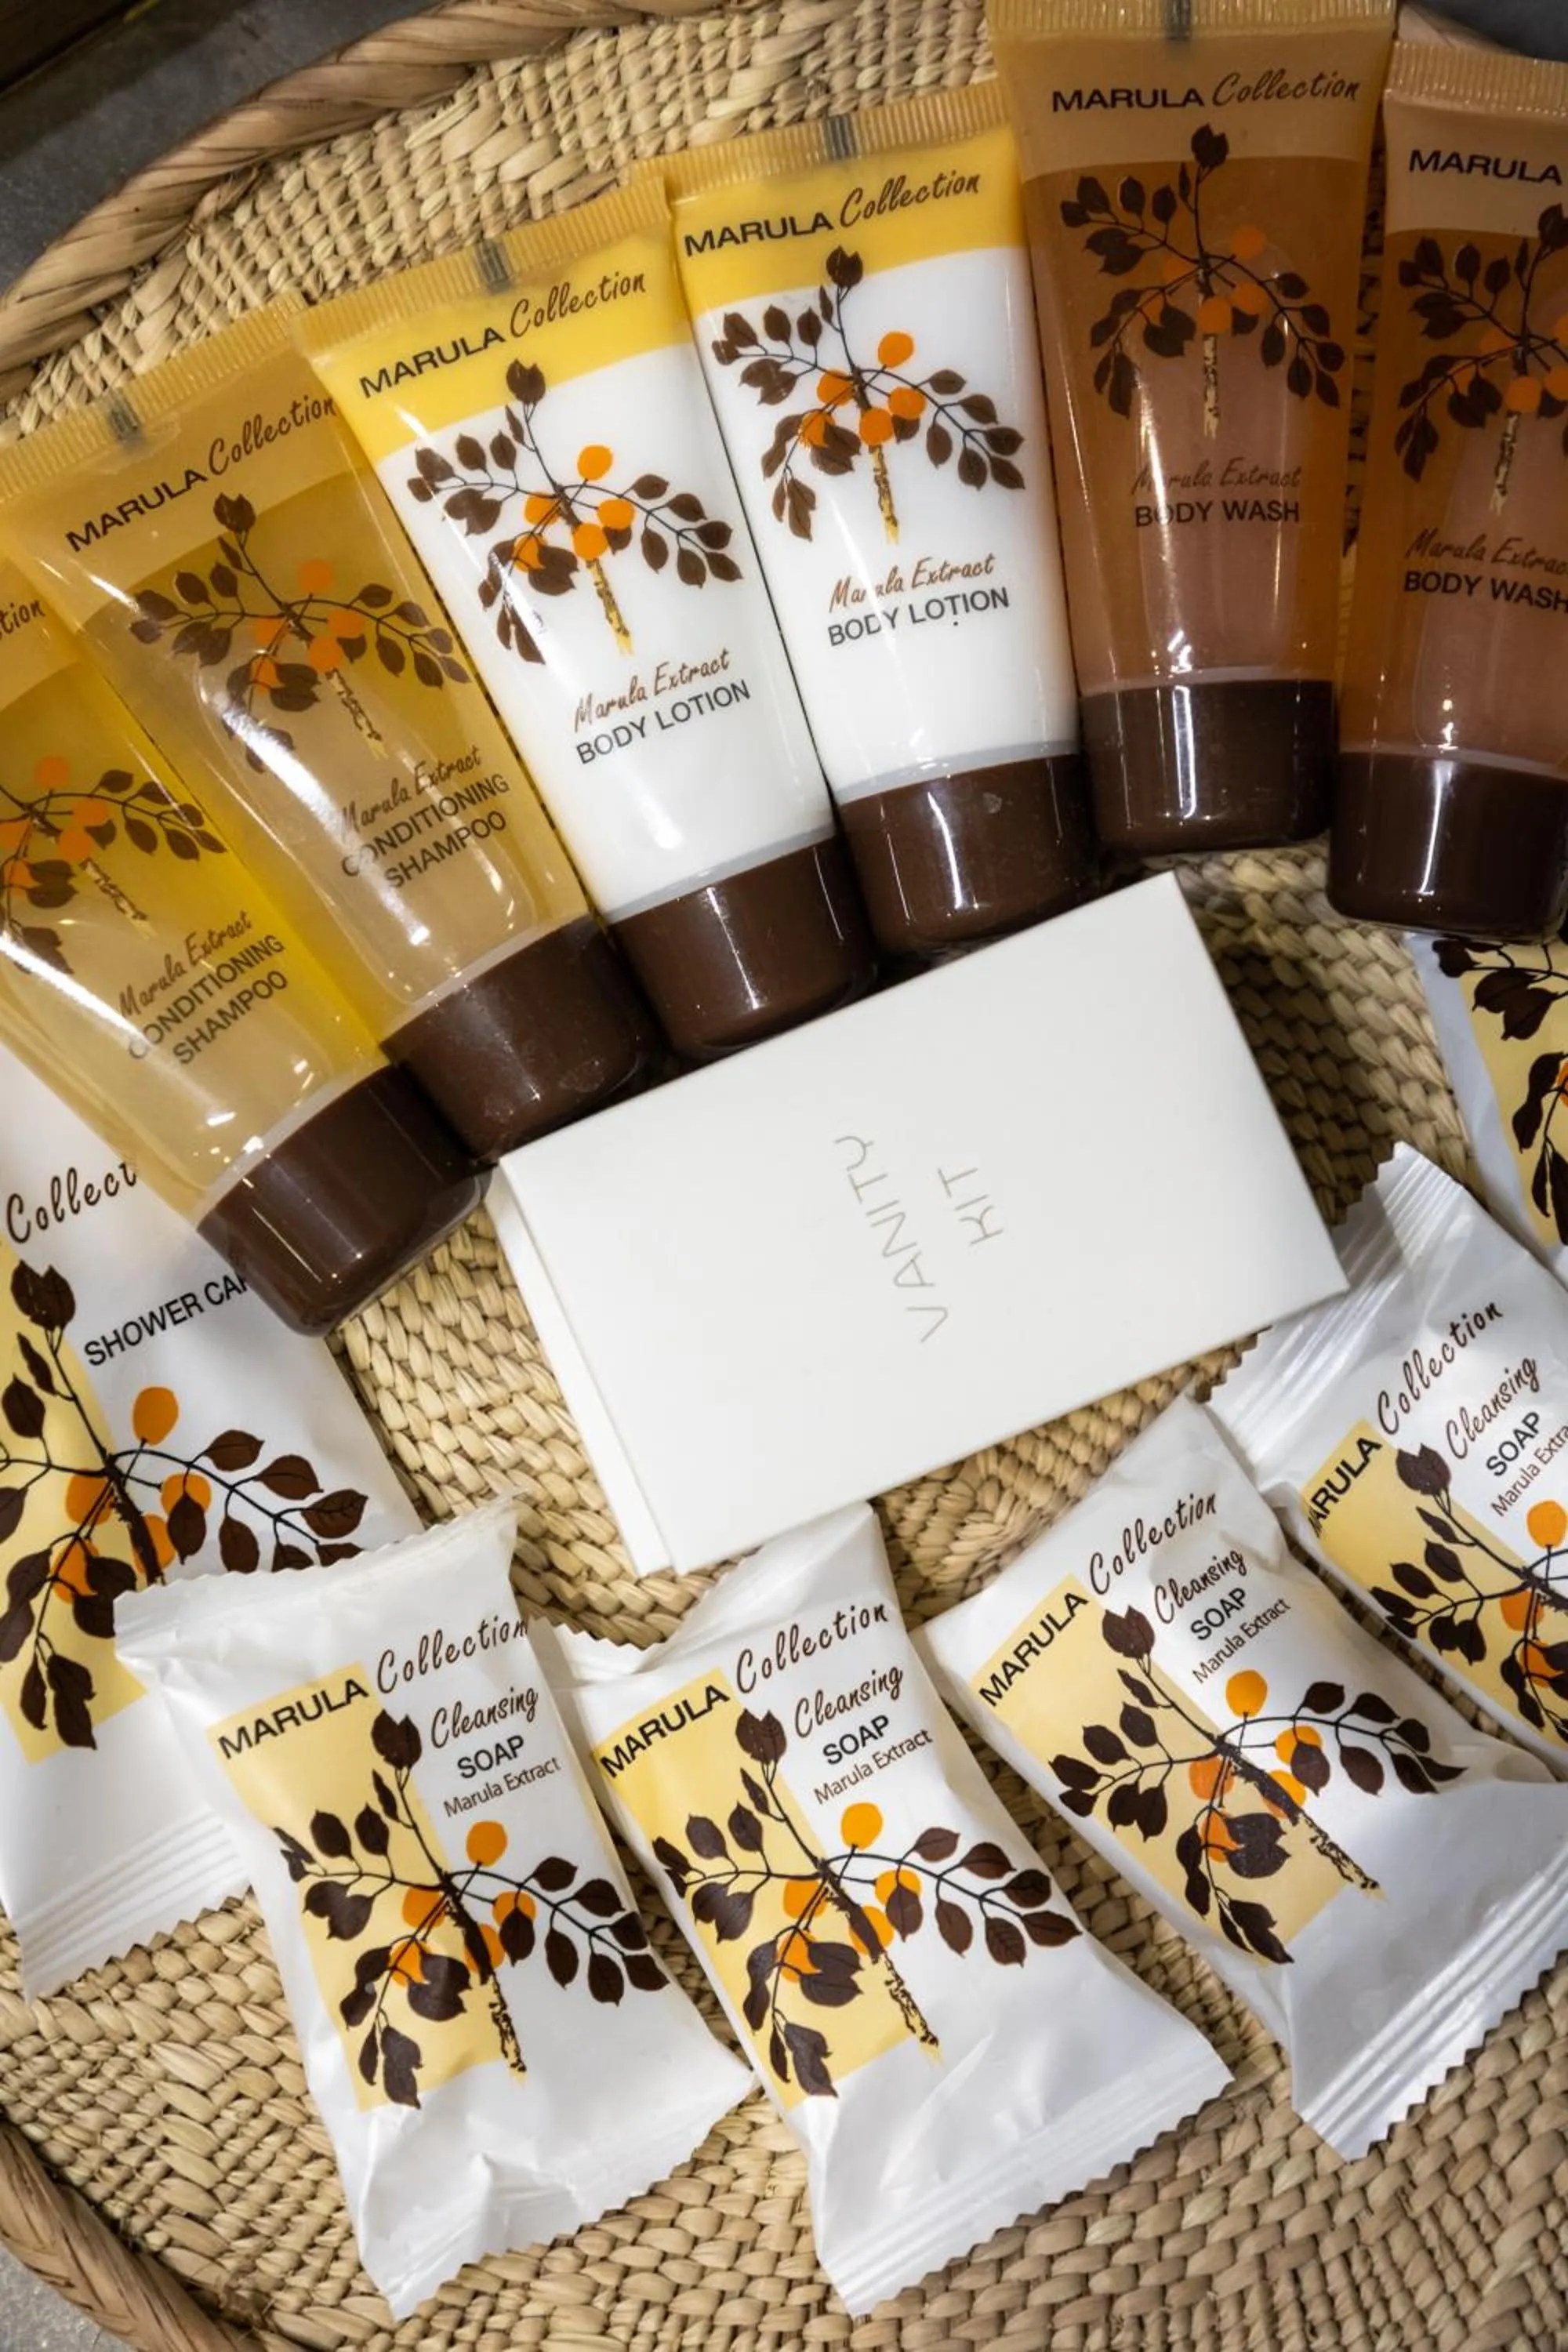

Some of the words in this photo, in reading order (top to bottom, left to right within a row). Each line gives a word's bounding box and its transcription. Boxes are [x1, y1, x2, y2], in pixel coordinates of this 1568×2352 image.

[1051, 86, 1204, 112] MARULA
[1211, 69, 1359, 107] Collection
[1409, 149, 1563, 186] MARULA
[684, 212, 833, 257] MARULA
[840, 169, 980, 227] Collection
[358, 326, 506, 398] MARULA
[509, 270, 646, 337] Collection
[65, 469, 209, 552] MARULA
[208, 394, 336, 475] Collection
[1220, 456, 1302, 488] Extract
[1221, 499, 1300, 523] WASH
[911, 552, 996, 589] Extract
[1404, 527, 1486, 561] Marula
[1491, 537, 1568, 575] Extrac
[828, 606, 899, 646] BODY
[908, 586, 1010, 625] LOTION
[1404, 570, 1483, 596] BODY
[1491, 577, 1568, 614] WASH
[574, 675, 648, 732] Marula
[654, 648, 730, 696] Extract
[576, 716, 646, 764] BODY
[655, 680, 751, 730] LOTION
[415, 744, 481, 796] Extract
[385, 811, 506, 888] SHAMPOO
[119, 953, 187, 1018] Marula
[184, 910, 252, 967] Extract
[173, 971, 288, 1065] SHAMPOO
[7, 1161, 138, 1243] Collect
[832, 1135, 949, 1343] VANITY
[938, 1168, 1004, 1246] KIT
[84, 1293, 204, 1366] SHOWER
[1377, 1302, 1504, 1435] Collection
[1446, 1357, 1541, 1460] Cleansing
[1486, 1411, 1540, 1477] SOAP
[1490, 1463, 1541, 1517] Marula
[979, 1592, 1089, 1706] MARULA
[1089, 1492, 1217, 1595] Collection
[1154, 1548, 1247, 1624] Cleansing
[1191, 1587, 1247, 1641] SOAP
[1192, 1637, 1245, 1684] Marula
[1240, 1598, 1291, 1639] Extract
[219, 1679, 369, 1759] MARULA
[376, 1615, 528, 1694] Collection
[430, 1686, 539, 1749] Cleansing
[600, 1684, 730, 1777] MARULA
[735, 1602, 888, 1693] Collection
[795, 1665, 904, 1737] Cleansing
[456, 1735, 525, 1780] SOAP
[813, 1762, 873, 1806] Marula
[875, 1729, 934, 1770] Extract
[823, 1715, 890, 1765] SOAP
[442, 1782, 503, 1818] Marula
[503, 1756, 561, 1793] Extract
